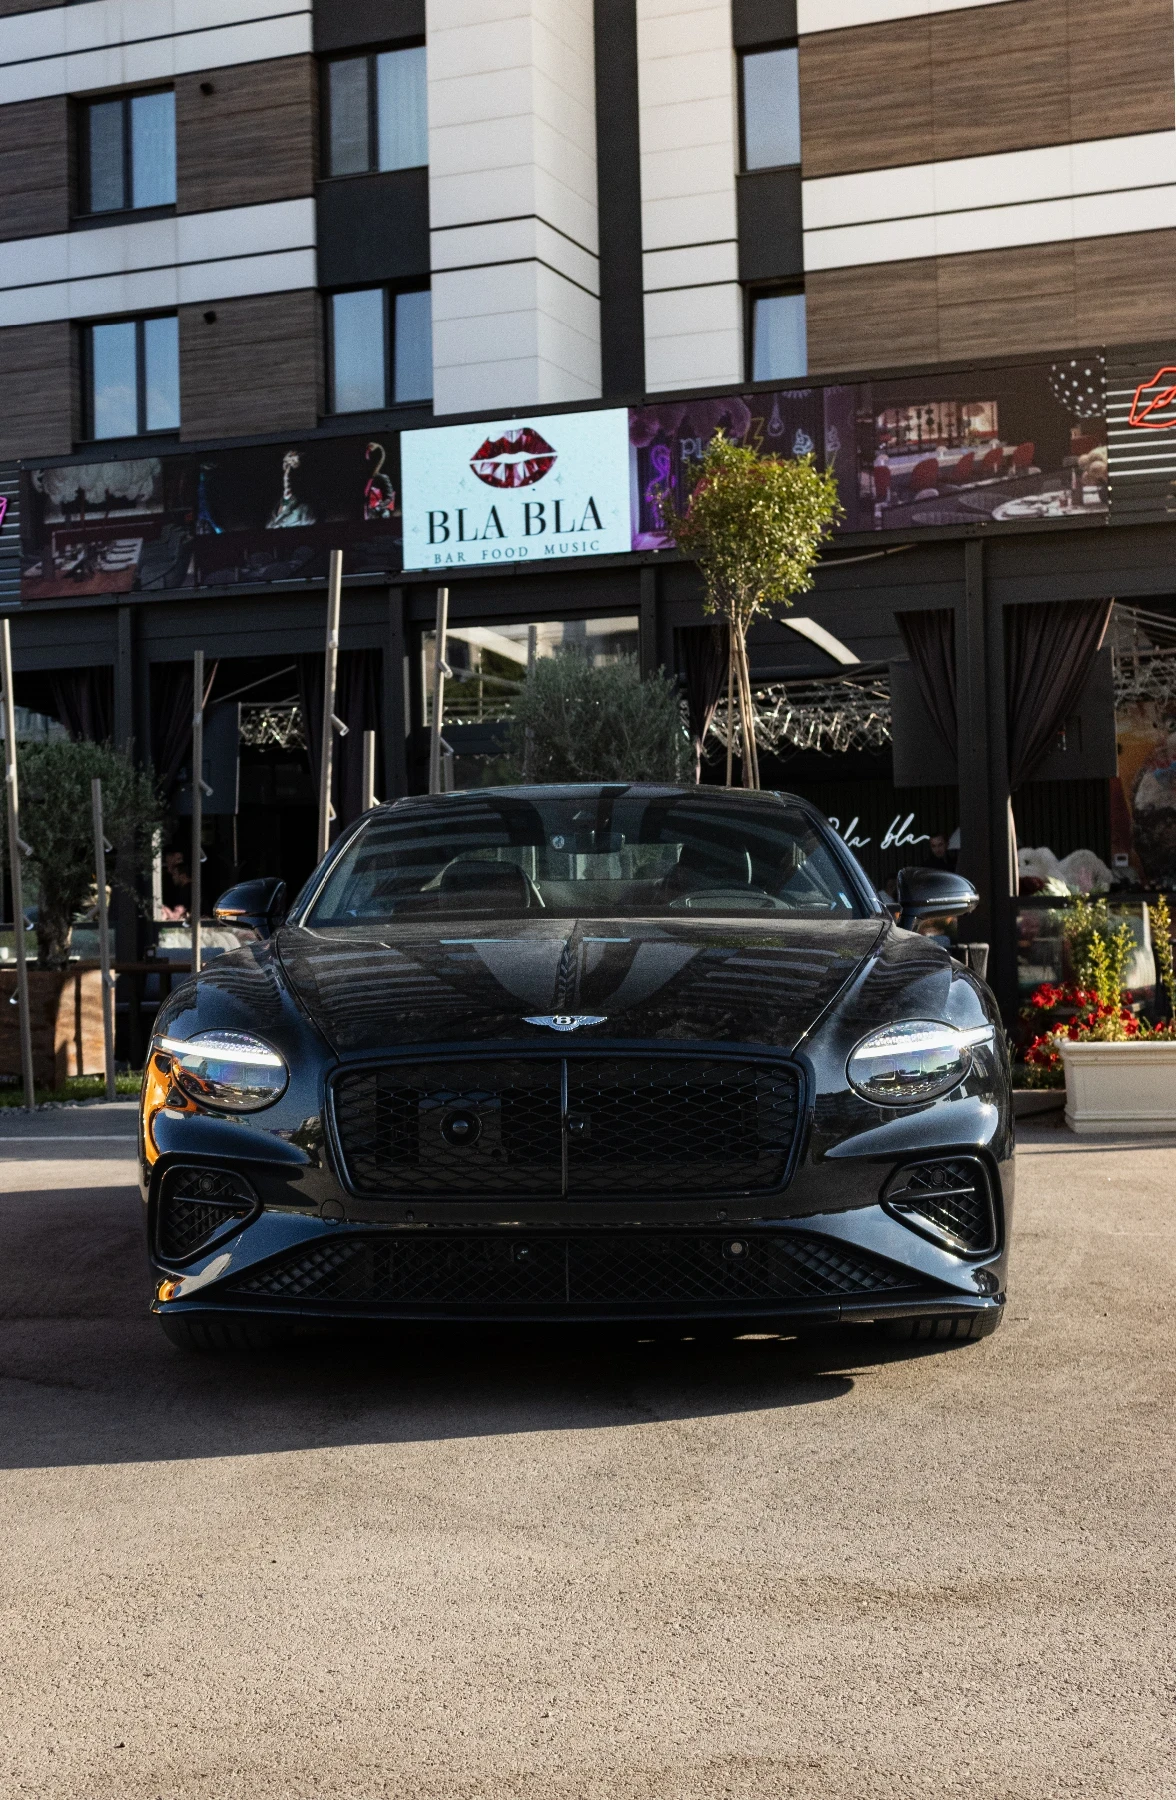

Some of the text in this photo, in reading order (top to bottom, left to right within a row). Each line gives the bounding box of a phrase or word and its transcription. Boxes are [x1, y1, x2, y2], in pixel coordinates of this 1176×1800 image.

[426, 495, 606, 545] BLA BLA
[434, 540, 600, 564] BAR FOOD MUSIC
[880, 812, 931, 850] bla
